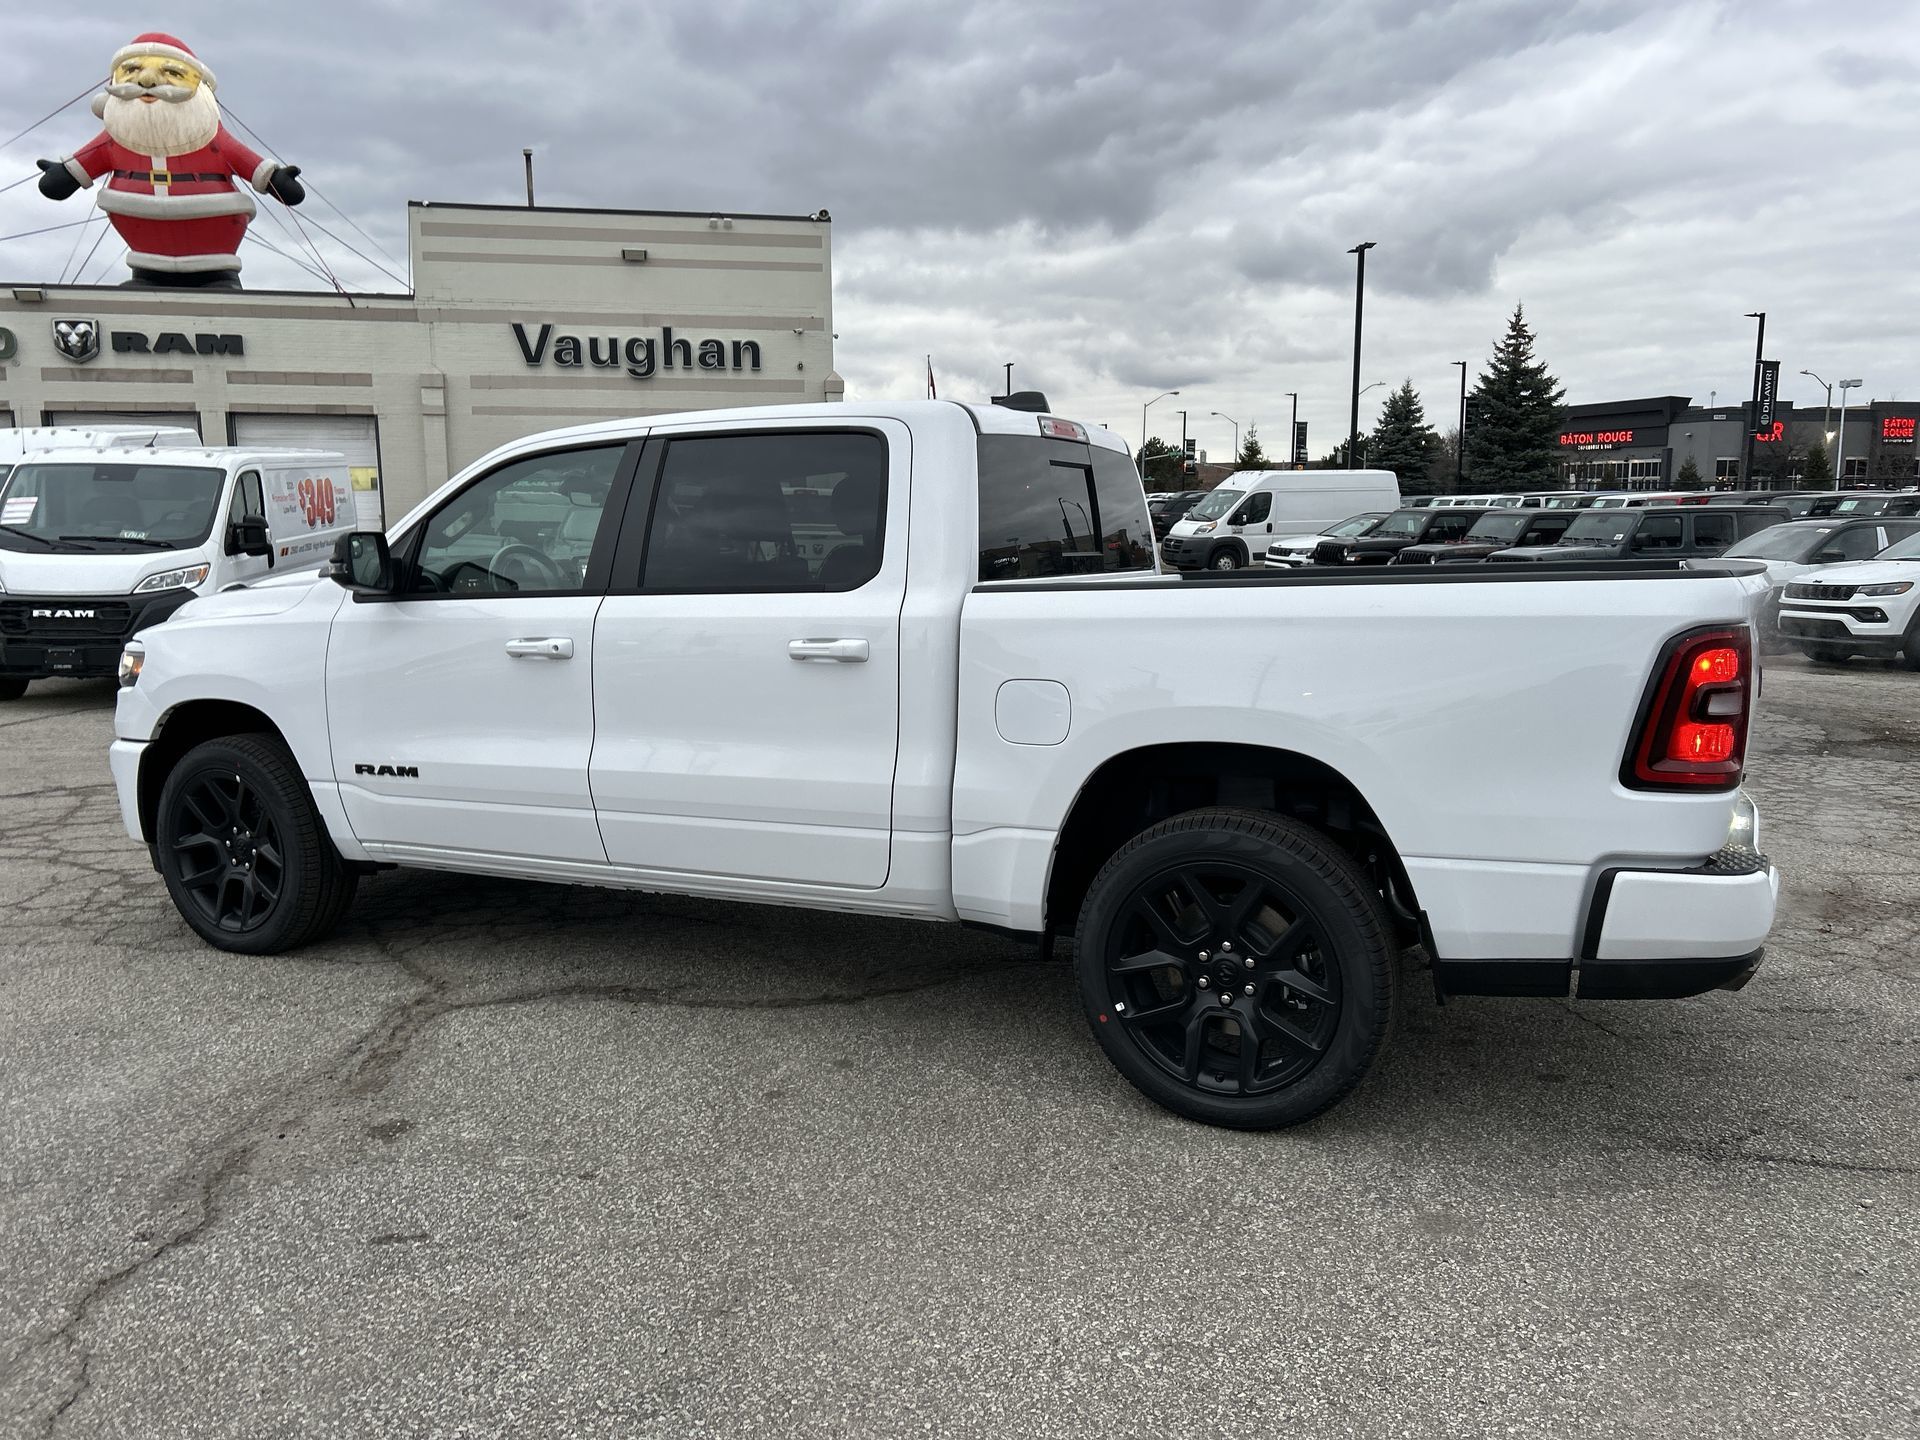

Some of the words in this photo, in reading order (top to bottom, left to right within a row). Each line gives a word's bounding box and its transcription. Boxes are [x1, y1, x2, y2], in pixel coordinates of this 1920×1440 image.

[111, 331, 244, 355] RAM
[511, 323, 762, 378] Vaughan
[1763, 370, 1772, 413] DILAWRI
[1597, 431, 1633, 443] ROUGE
[1883, 428, 1914, 437] ROUGE
[297, 477, 335, 529] $349
[32, 609, 95, 618] RAM
[354, 764, 419, 778] RAM
